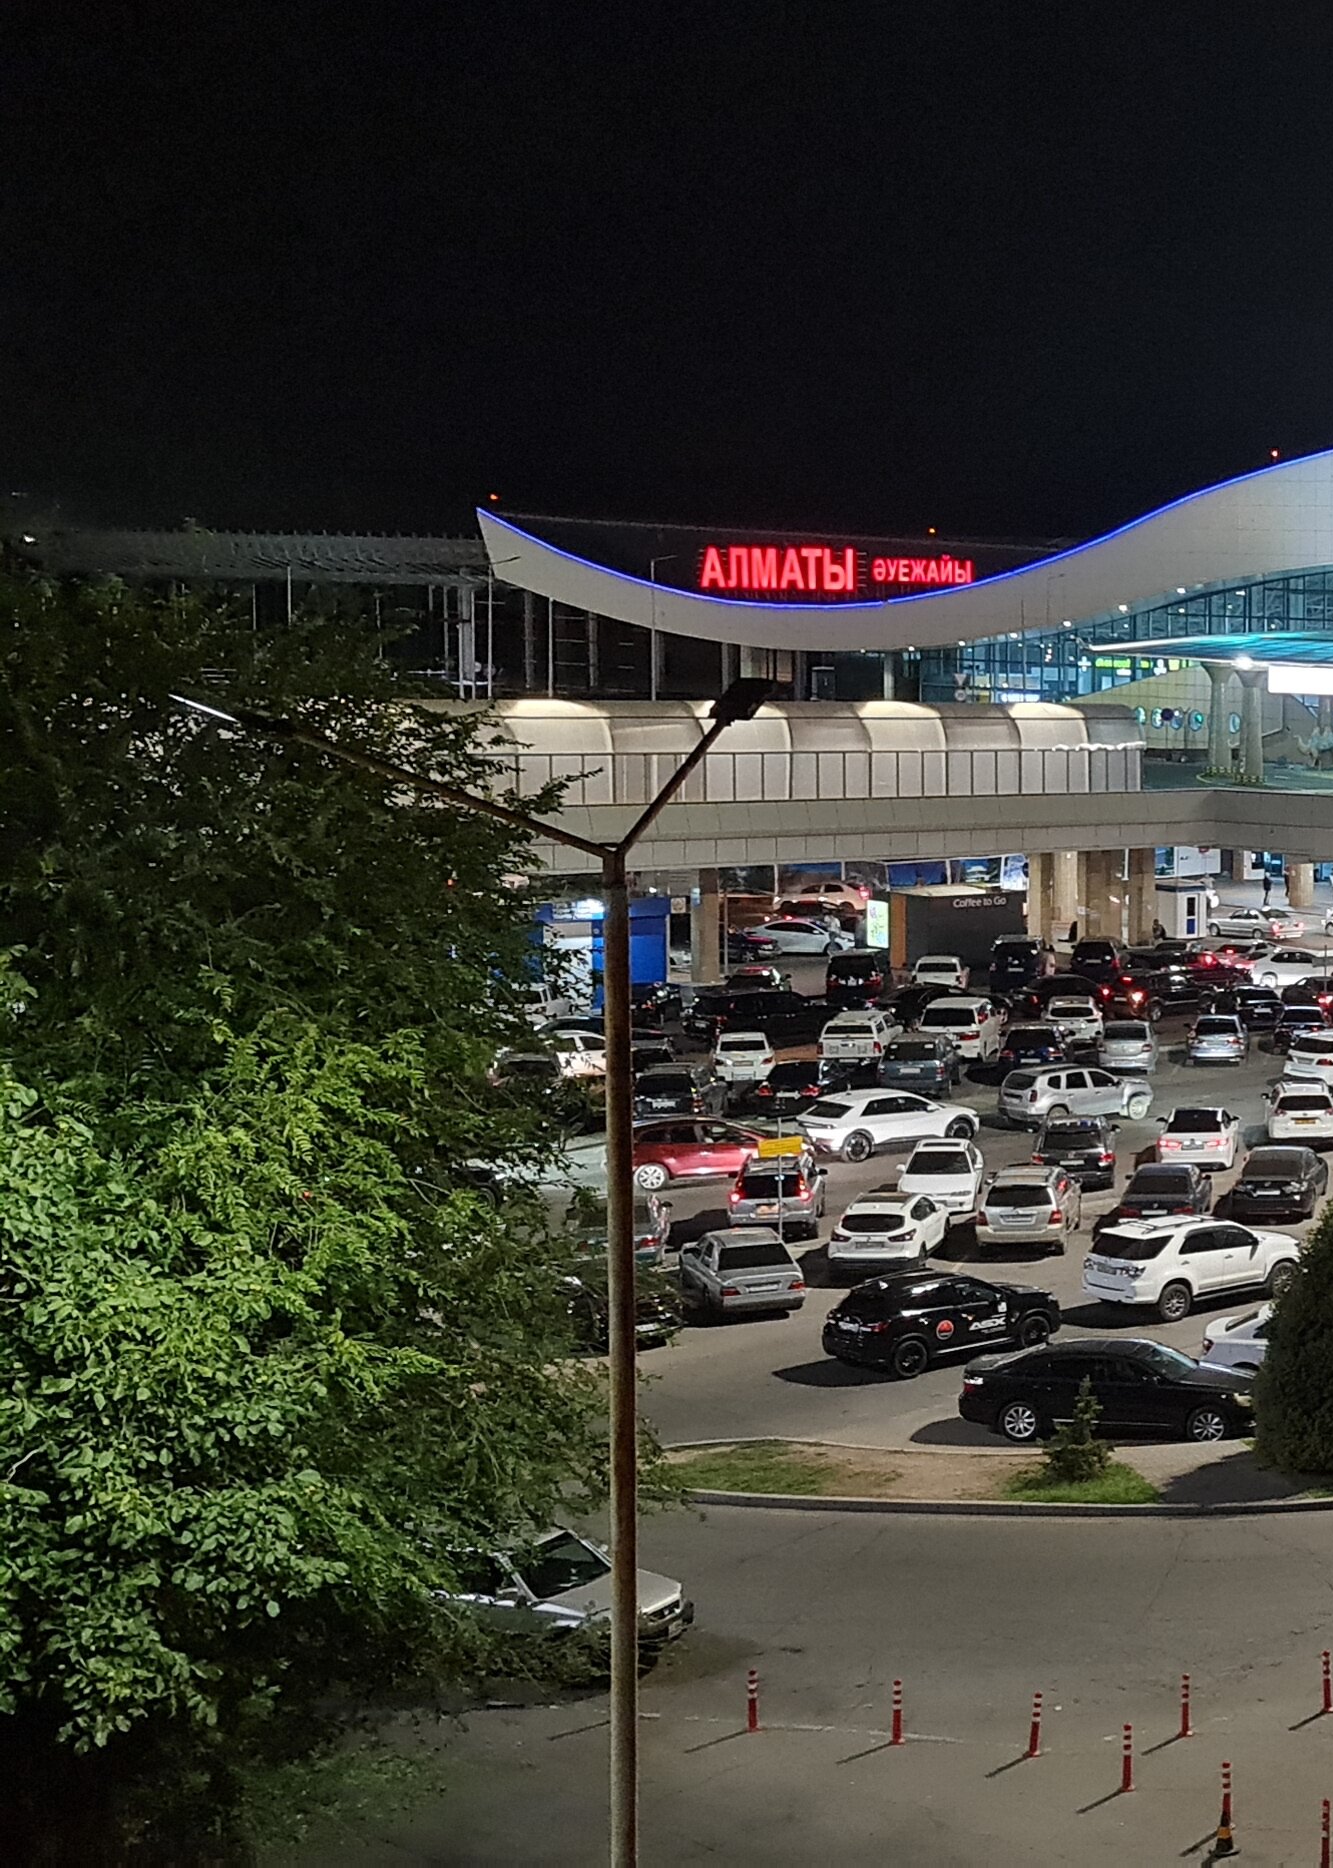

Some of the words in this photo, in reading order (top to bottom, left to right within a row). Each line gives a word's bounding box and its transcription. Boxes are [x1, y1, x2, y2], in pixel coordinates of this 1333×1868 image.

[701, 547, 854, 591] АЛМАТЫ
[872, 554, 972, 584] ӘУЕЖАЙЫ
[953, 898, 982, 908] Coffee
[983, 897, 993, 906] to
[993, 896, 1007, 905] Go
[968, 1316, 1007, 1331] ASX
